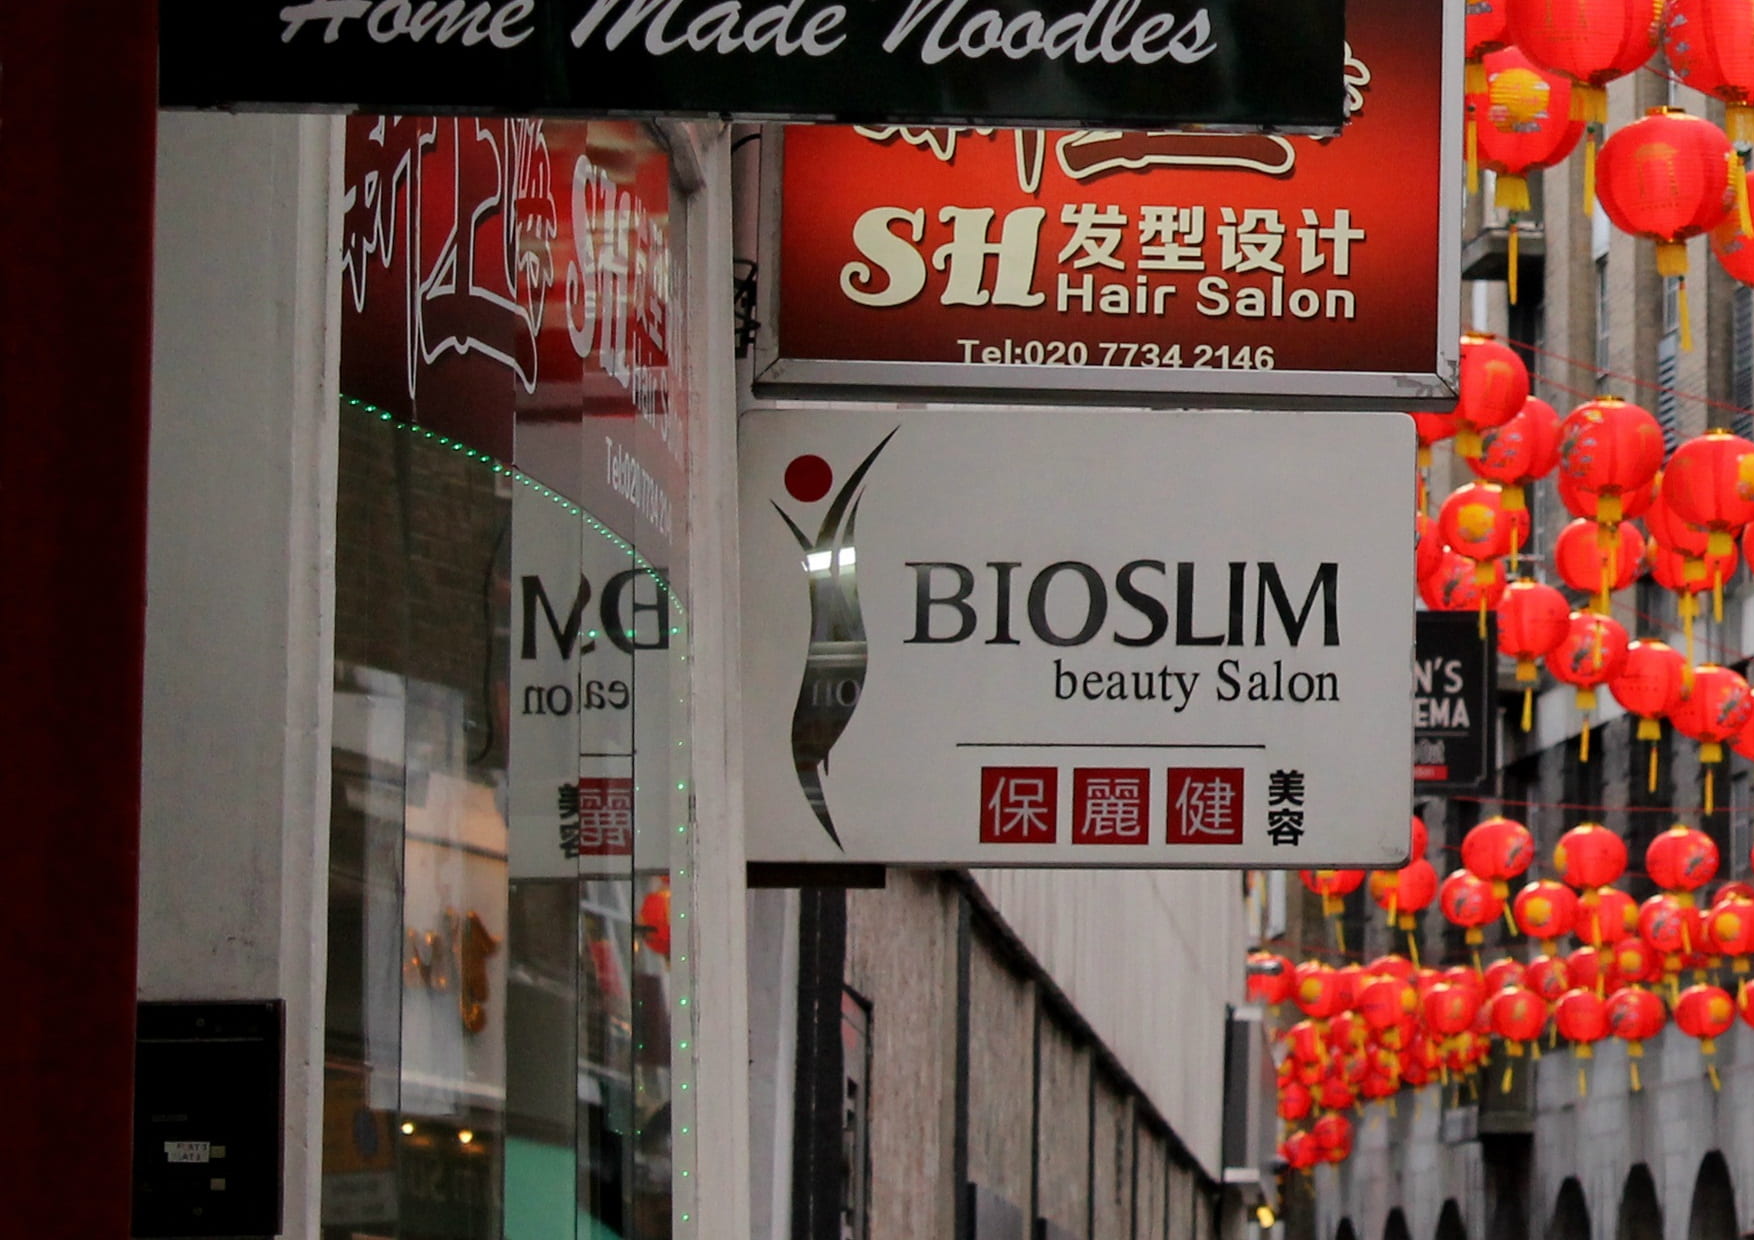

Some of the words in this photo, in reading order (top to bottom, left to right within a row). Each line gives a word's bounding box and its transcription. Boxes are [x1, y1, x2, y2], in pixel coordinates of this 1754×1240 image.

[840, 205, 1046, 308] SH
[1057, 202, 1365, 277] 发型设计
[1057, 273, 1175, 316] Hair
[1197, 275, 1356, 319] Salon
[957, 339, 1089, 367] Tel:020
[1098, 341, 1183, 369] 7734
[1193, 344, 1275, 371] 2146
[903, 559, 1340, 647] BIOSLIM
[1054, 659, 1200, 713] beauty
[1217, 660, 1341, 703] Salon
[987, 775, 1236, 840] 保麗健
[1266, 769, 1306, 847] 美容
